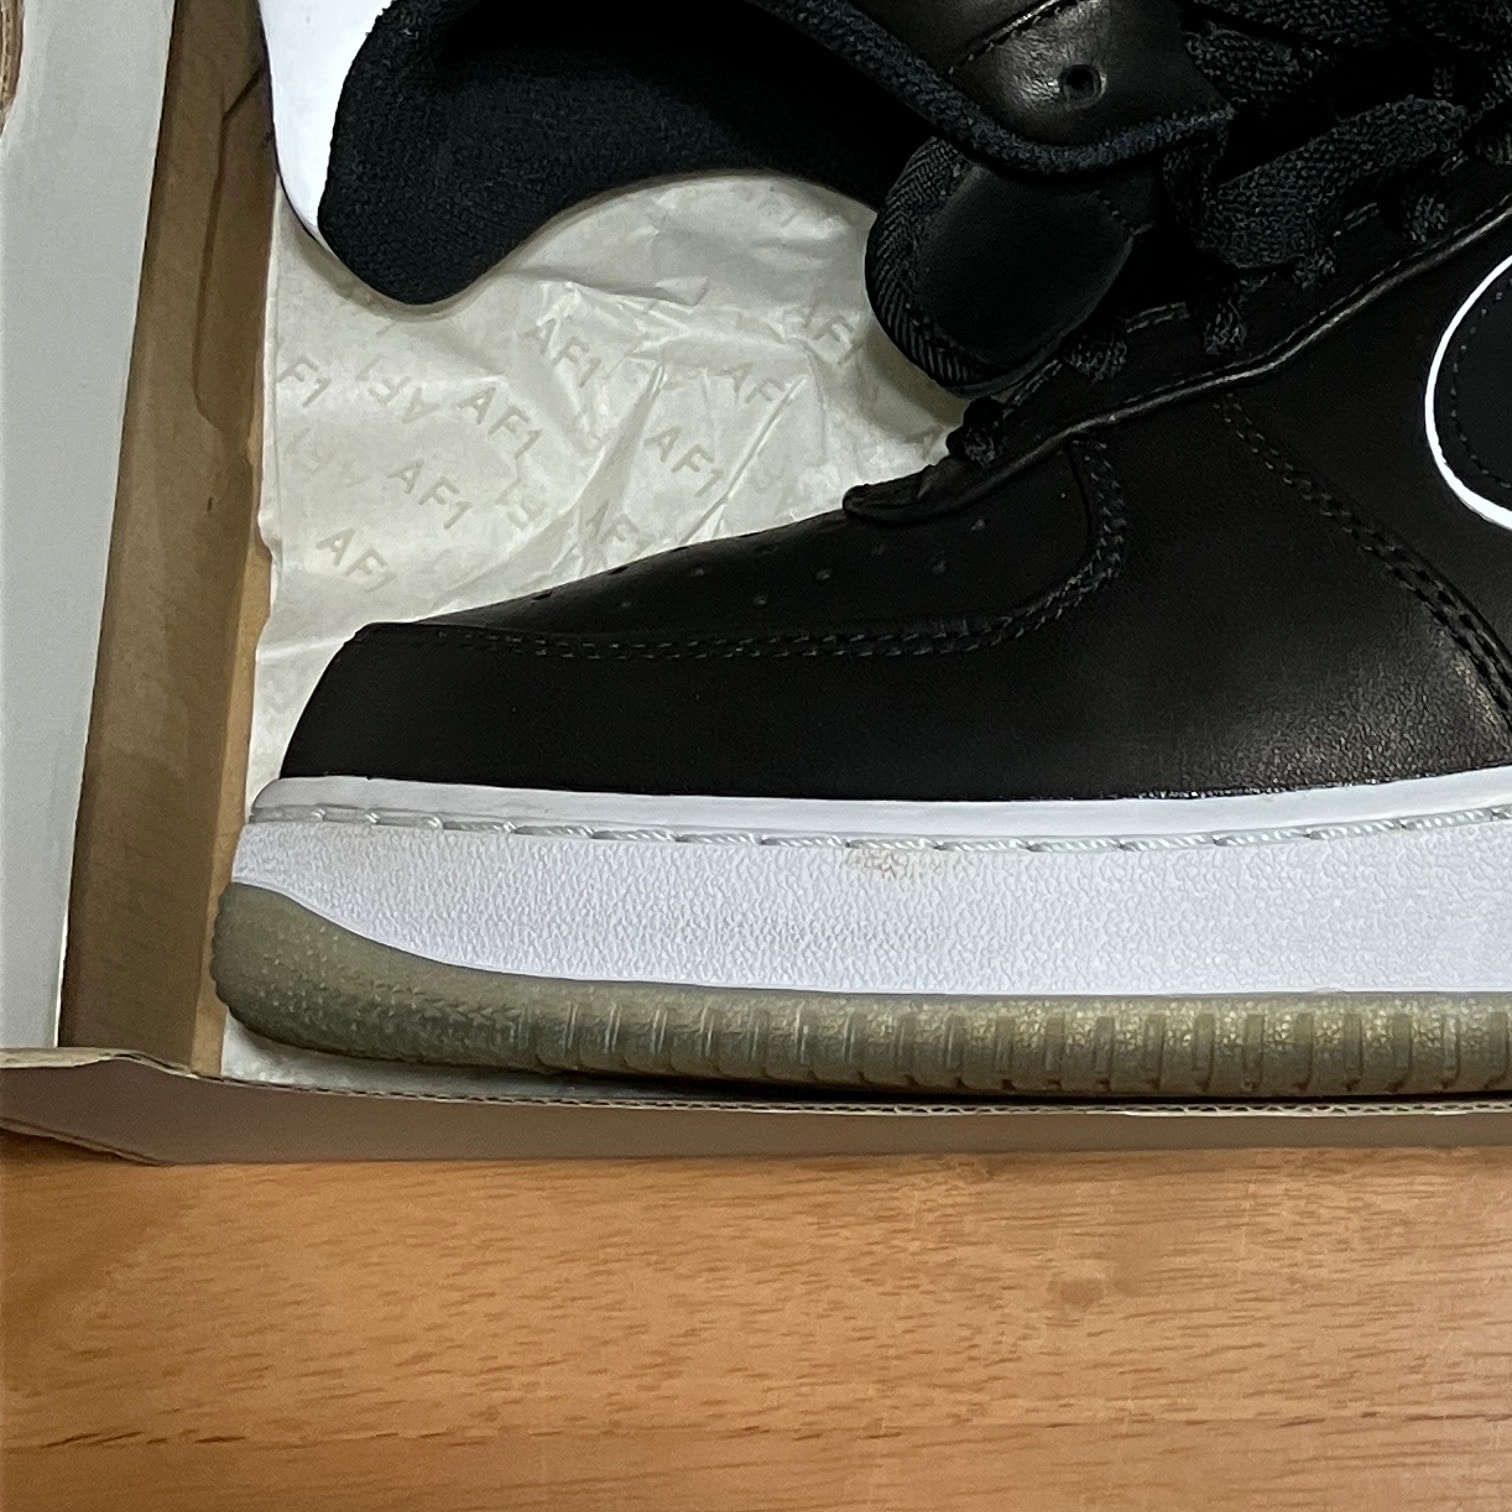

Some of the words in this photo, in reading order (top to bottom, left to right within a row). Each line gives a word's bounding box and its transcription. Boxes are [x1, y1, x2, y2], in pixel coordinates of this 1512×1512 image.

[276, 353, 332, 408] F1
[519, 316, 602, 389] AF1
[716, 363, 788, 405] AF
[456, 386, 544, 461] AF1
[385, 457, 473, 530] AF1
[643, 424, 725, 499] AF1
[314, 527, 397, 593] AF1
